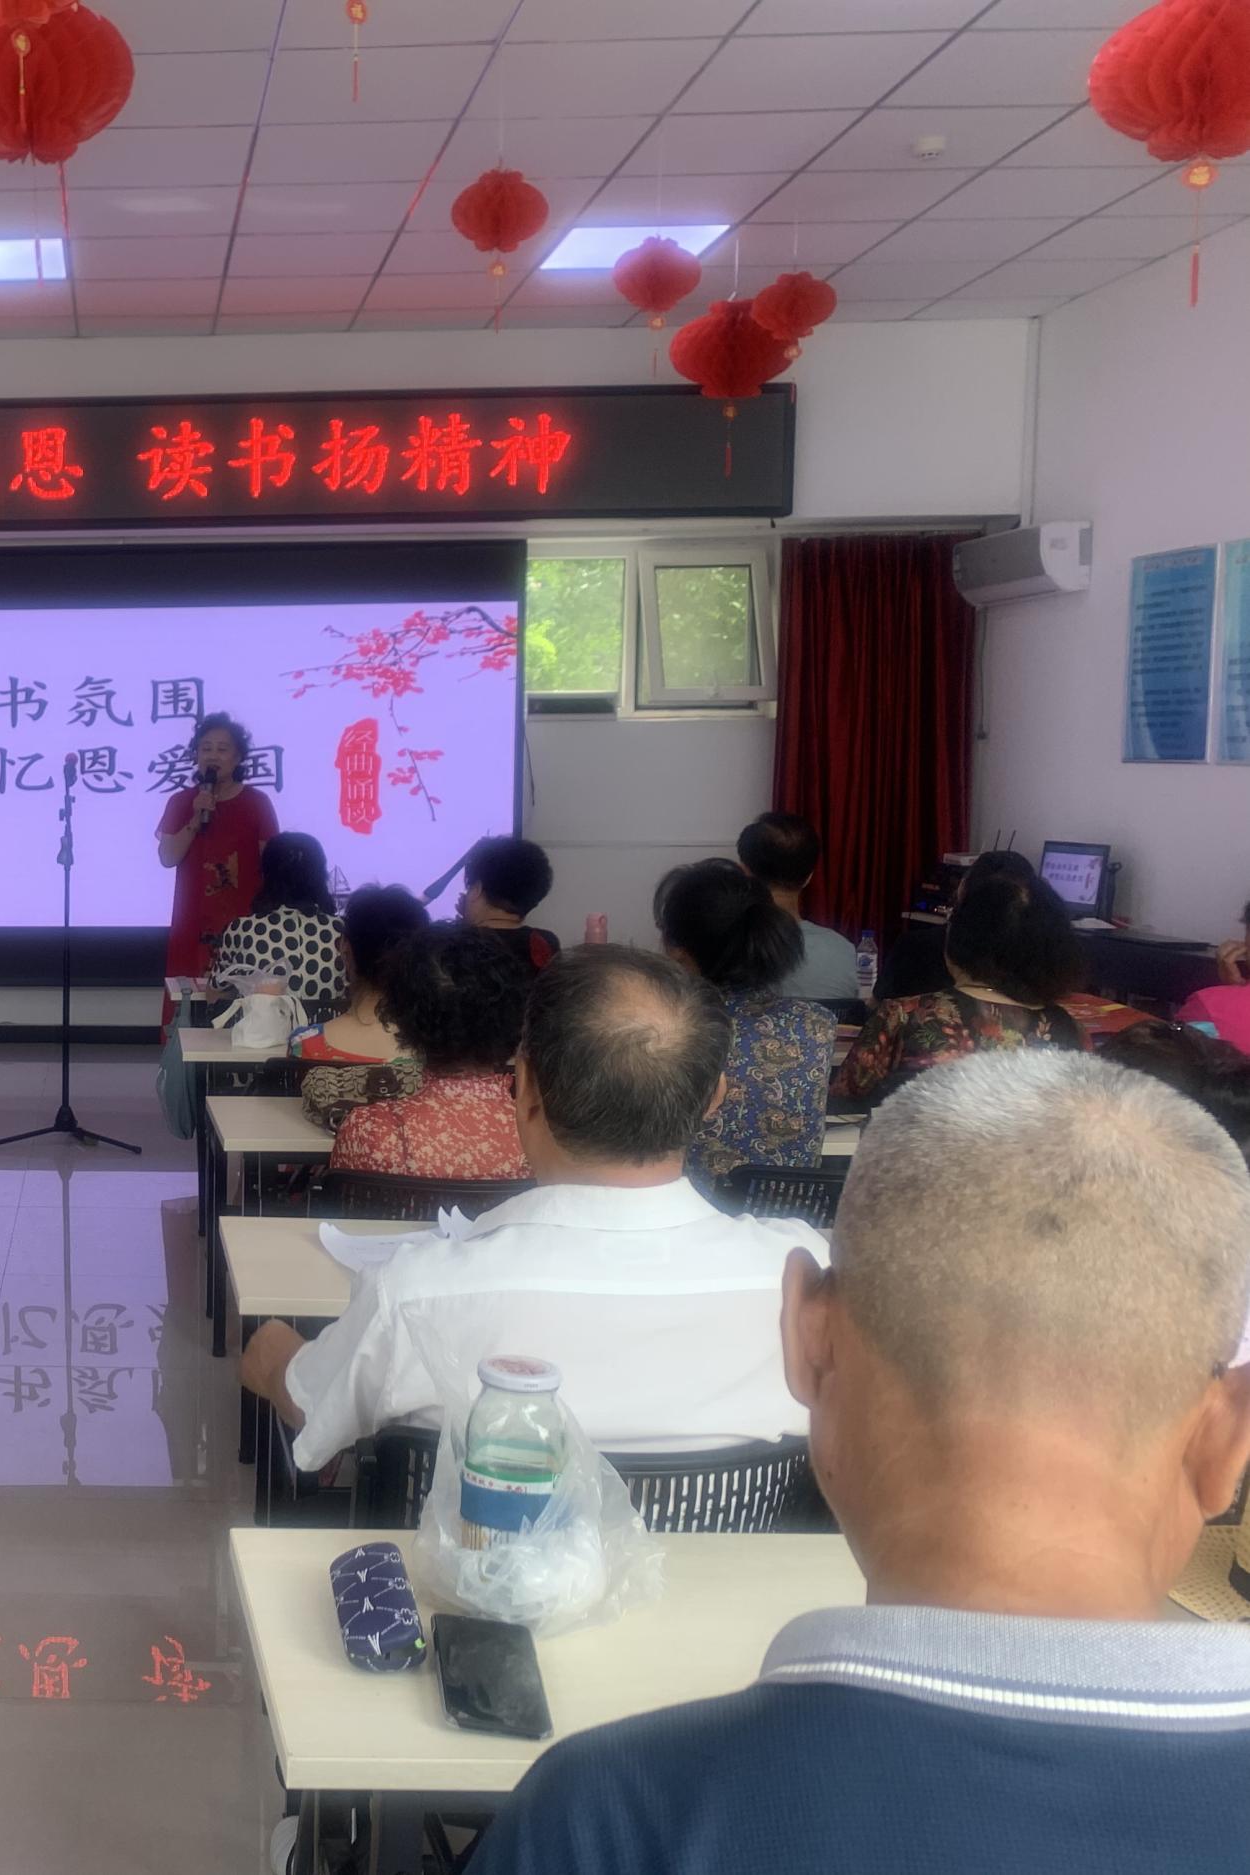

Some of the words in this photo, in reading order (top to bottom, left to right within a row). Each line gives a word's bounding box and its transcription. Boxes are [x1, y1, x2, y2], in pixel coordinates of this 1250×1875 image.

[136, 412, 574, 502] 读书扬精神
